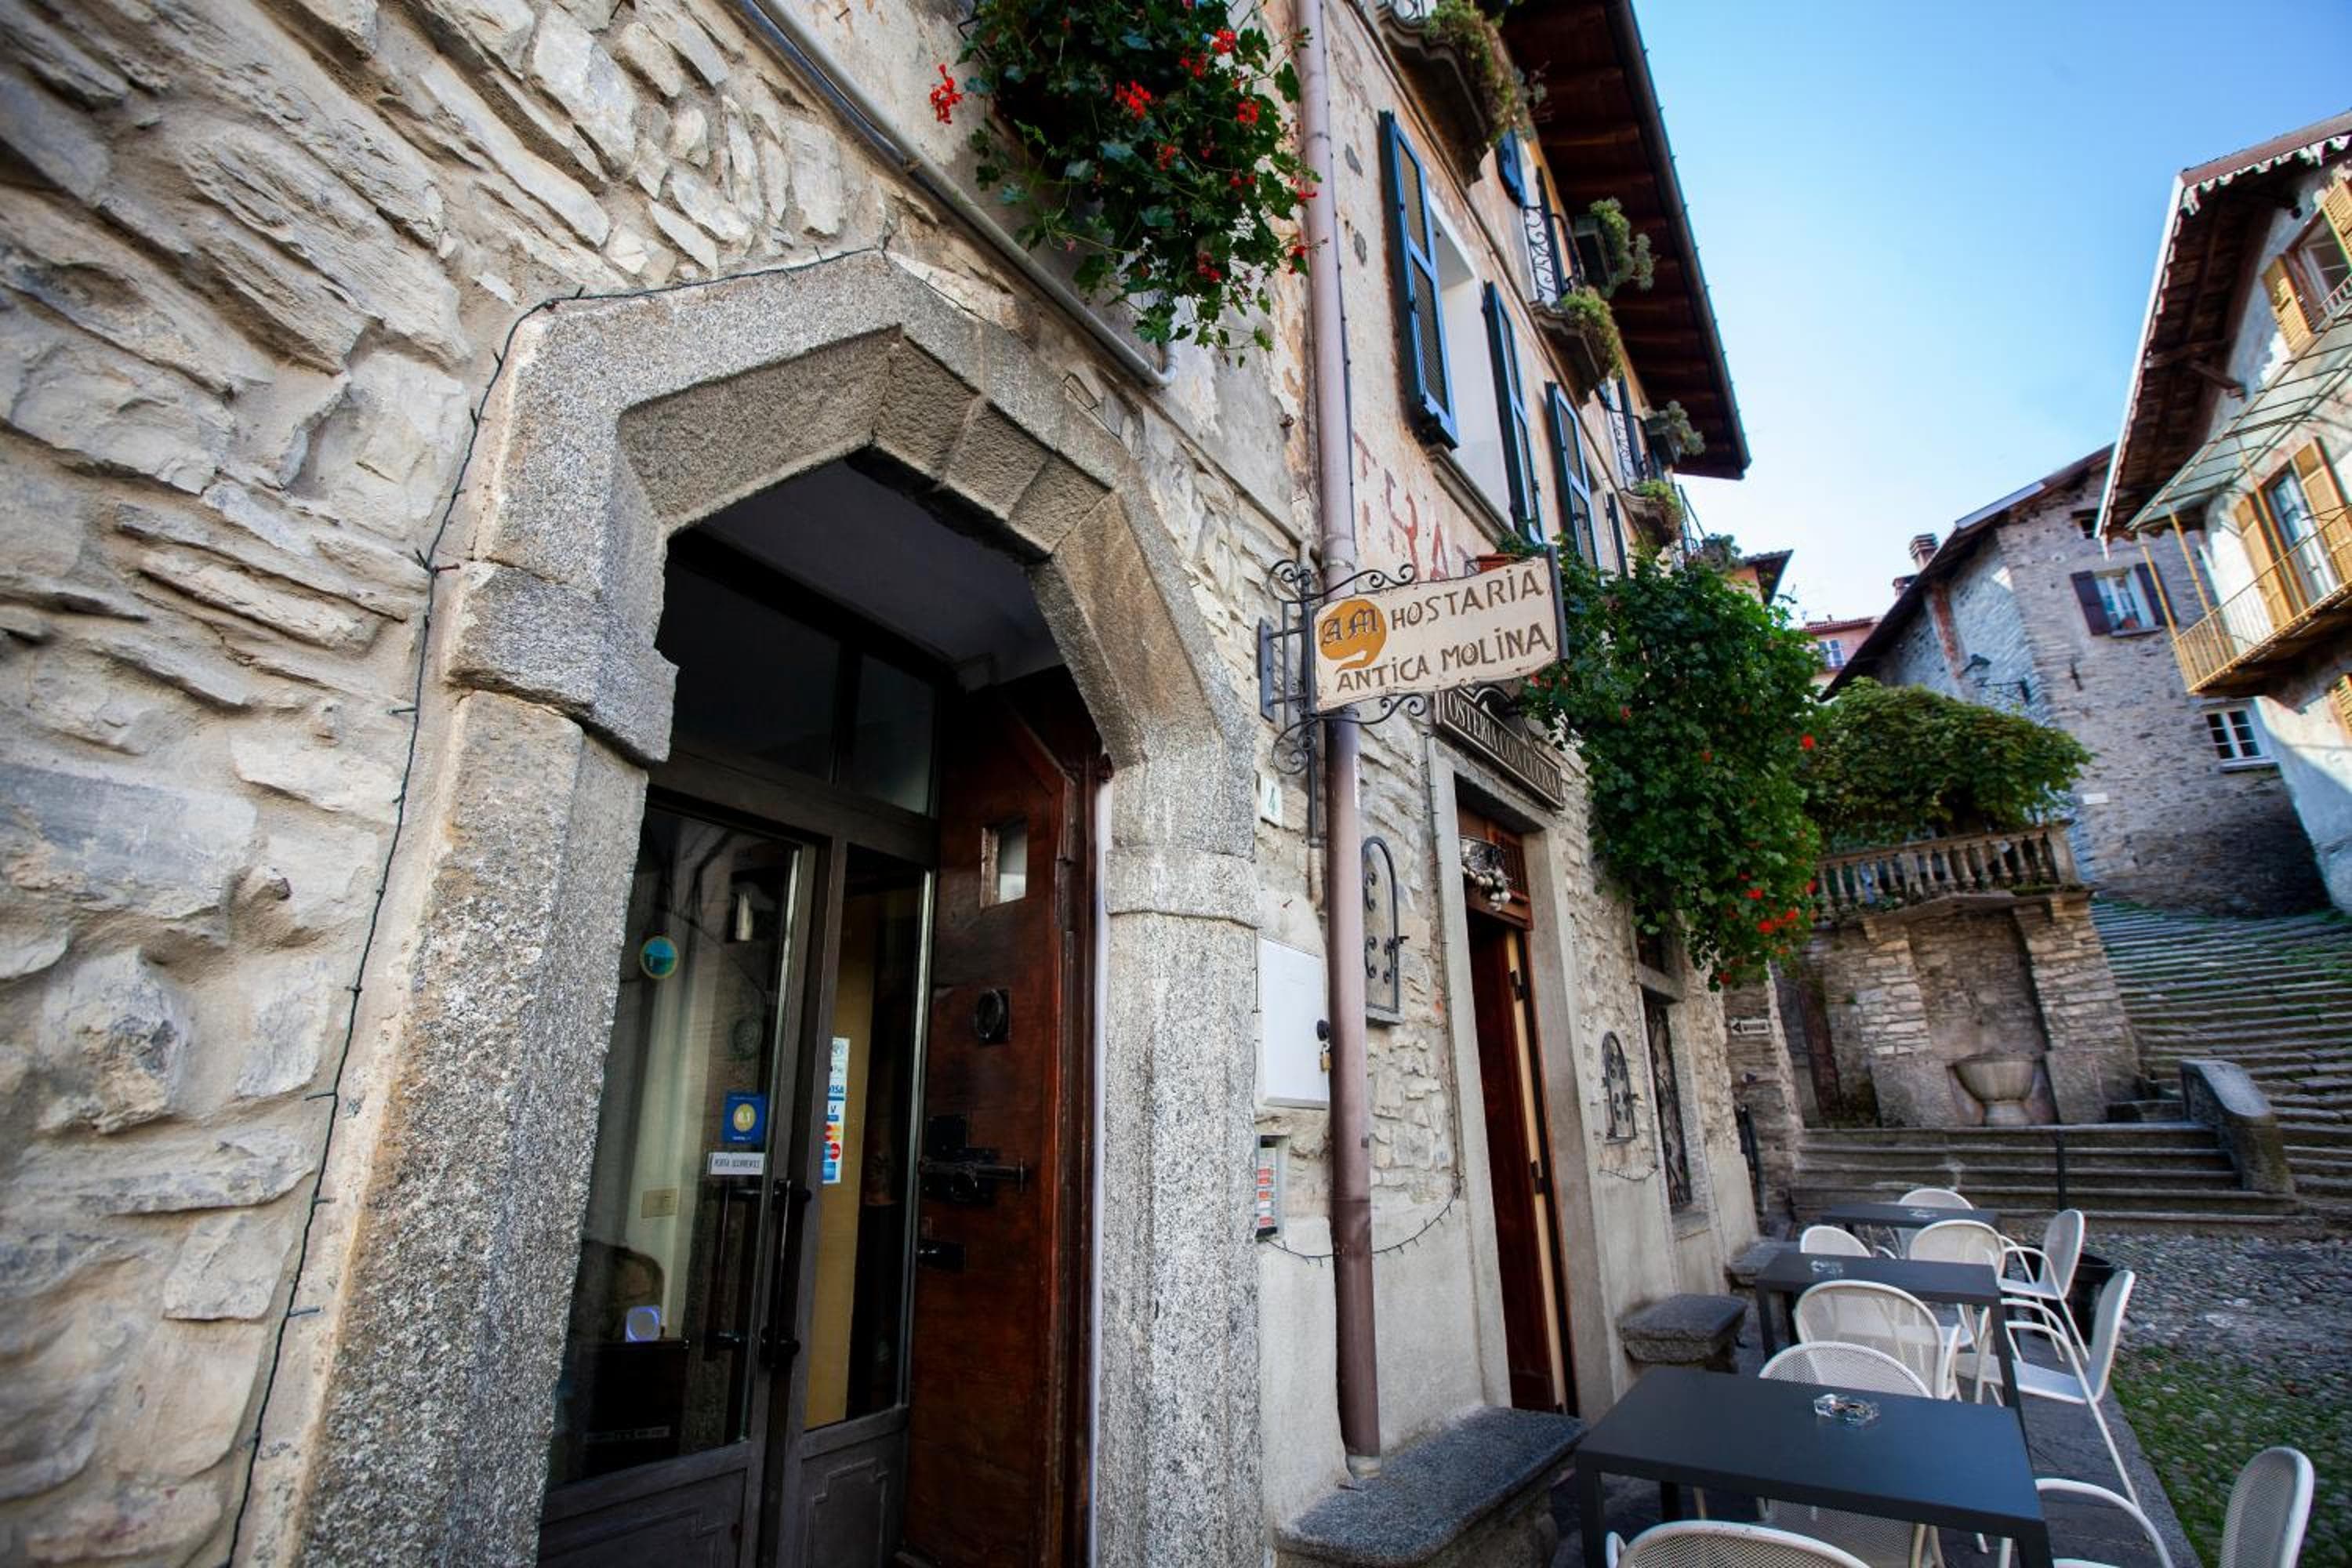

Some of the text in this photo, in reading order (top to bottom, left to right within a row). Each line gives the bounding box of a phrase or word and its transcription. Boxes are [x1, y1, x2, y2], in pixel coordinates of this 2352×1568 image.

[1391, 568, 1544, 630] HOSTARIA
[1336, 622, 1553, 692] ANTICA MOLINA
[1448, 691, 1499, 753] OSTERIA
